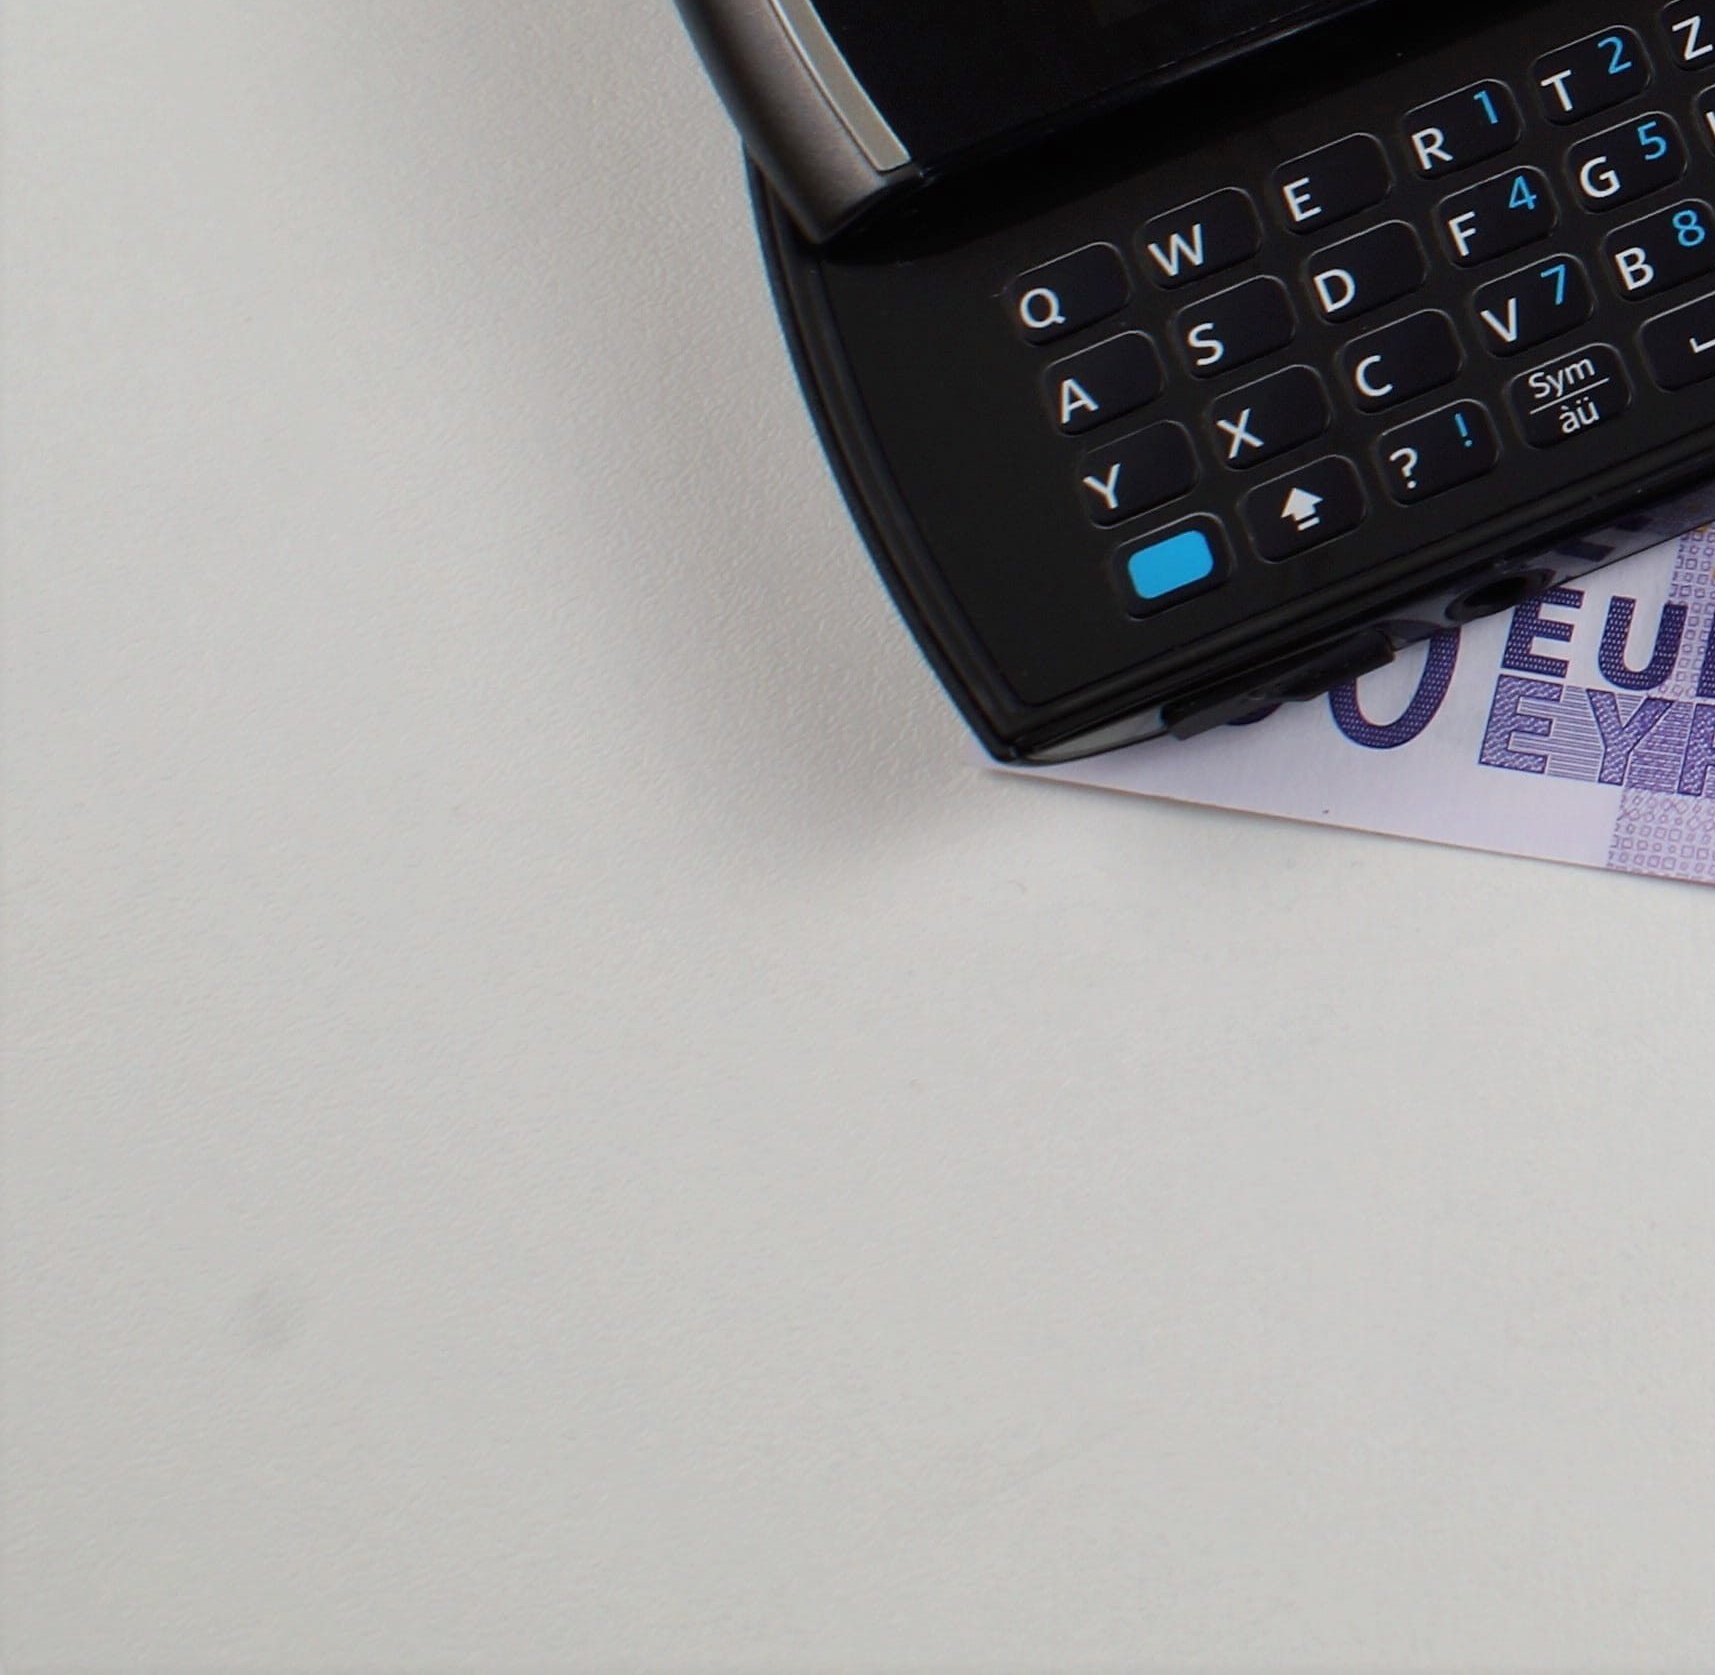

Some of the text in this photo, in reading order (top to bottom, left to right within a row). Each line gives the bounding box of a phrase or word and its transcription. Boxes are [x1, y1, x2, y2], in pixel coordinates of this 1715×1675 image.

[1671, 15, 1714, 61] Z
[1540, 32, 1632, 112] T 2
[1411, 90, 1499, 170] R 1
[1579, 120, 1667, 198] G 5
[1282, 177, 1322, 222] E
[1448, 175, 1537, 257] F 4
[1147, 223, 1204, 277] W
[1614, 209, 1706, 291] B 8
[1019, 287, 1067, 329] Q
[1313, 268, 1356, 313] D
[1480, 263, 1566, 342] V 7
[1187, 322, 1225, 366] S
[1355, 354, 1393, 397] C
[1526, 353, 1595, 402] Sym
[1060, 378, 1099, 424] A
[1558, 394, 1601, 436] àü
[1216, 407, 1265, 459] X
[1389, 413, 1473, 489] ? !
[1082, 463, 1121, 509] Y
